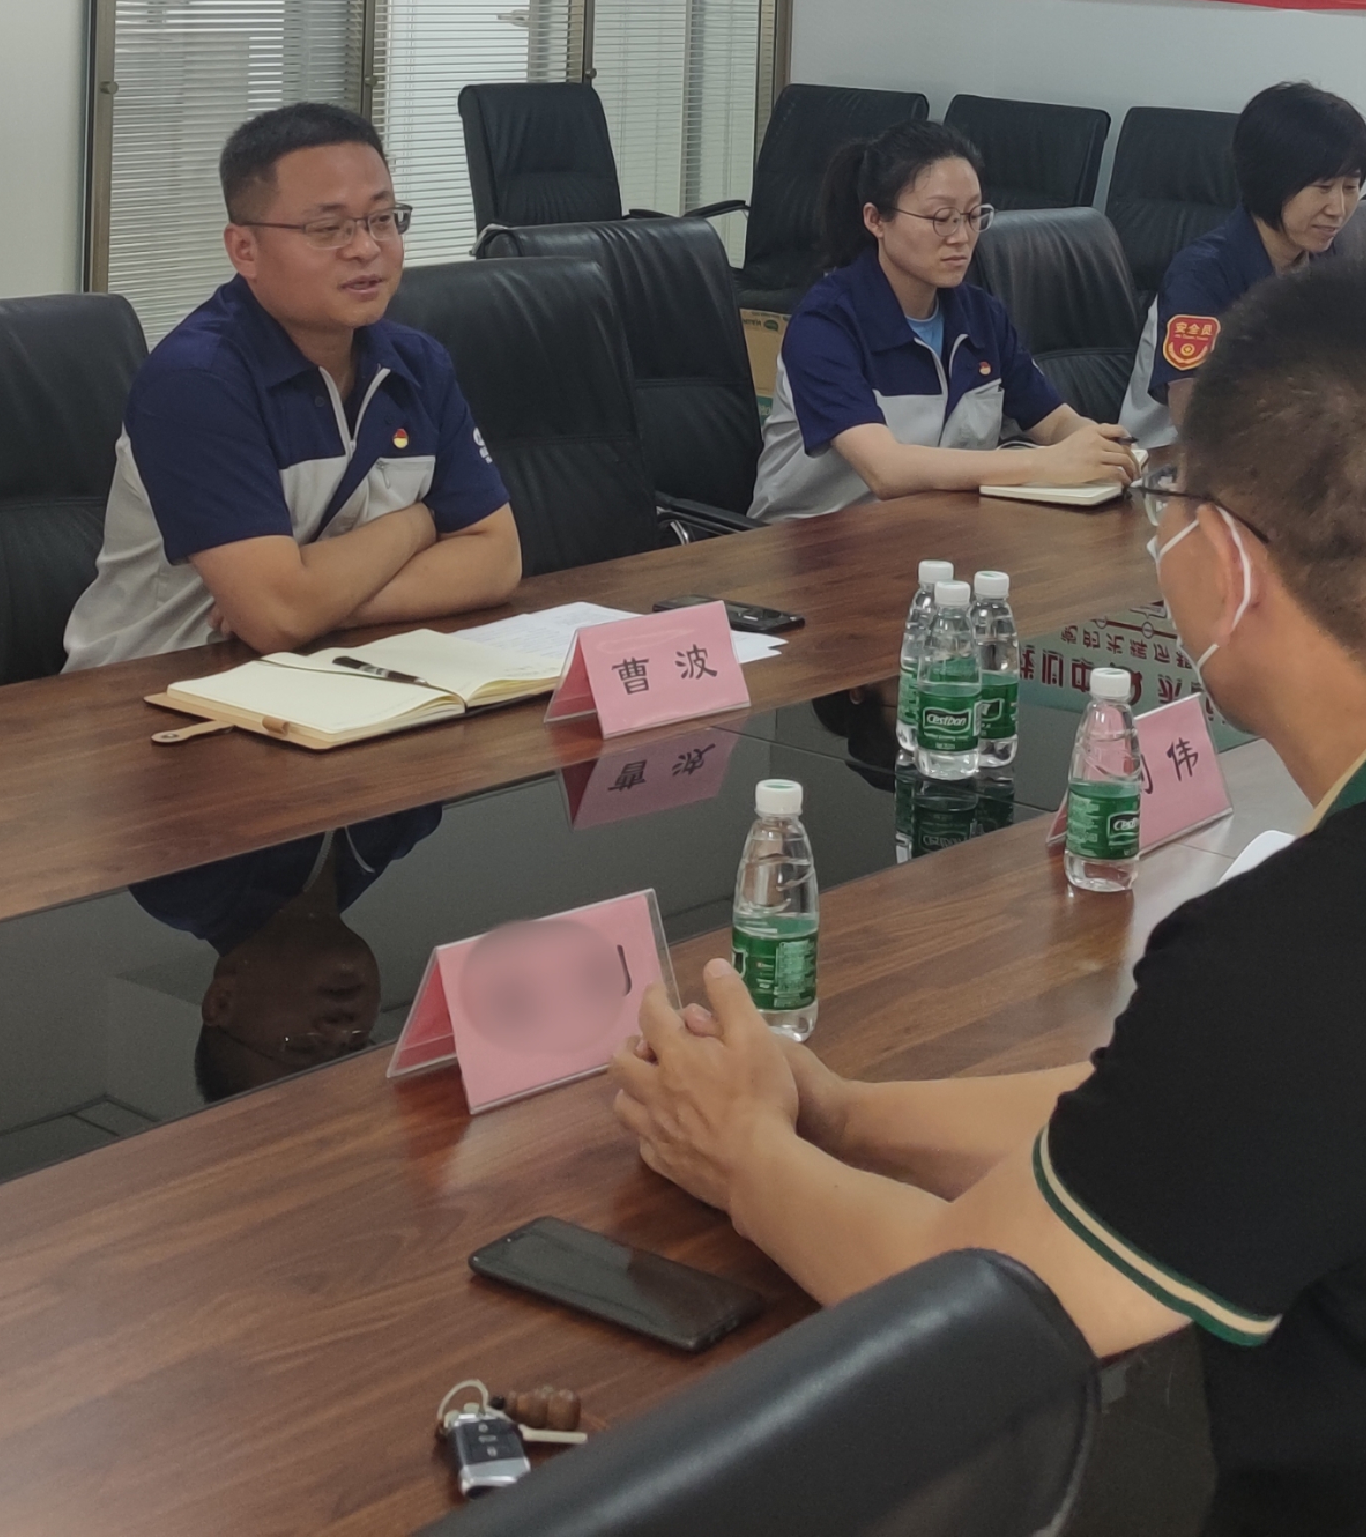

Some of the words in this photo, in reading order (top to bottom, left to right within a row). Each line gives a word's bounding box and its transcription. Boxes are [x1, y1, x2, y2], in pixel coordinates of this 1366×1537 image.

[1175, 322, 1213, 335] 安全员
[612, 644, 718, 695] 曹波
